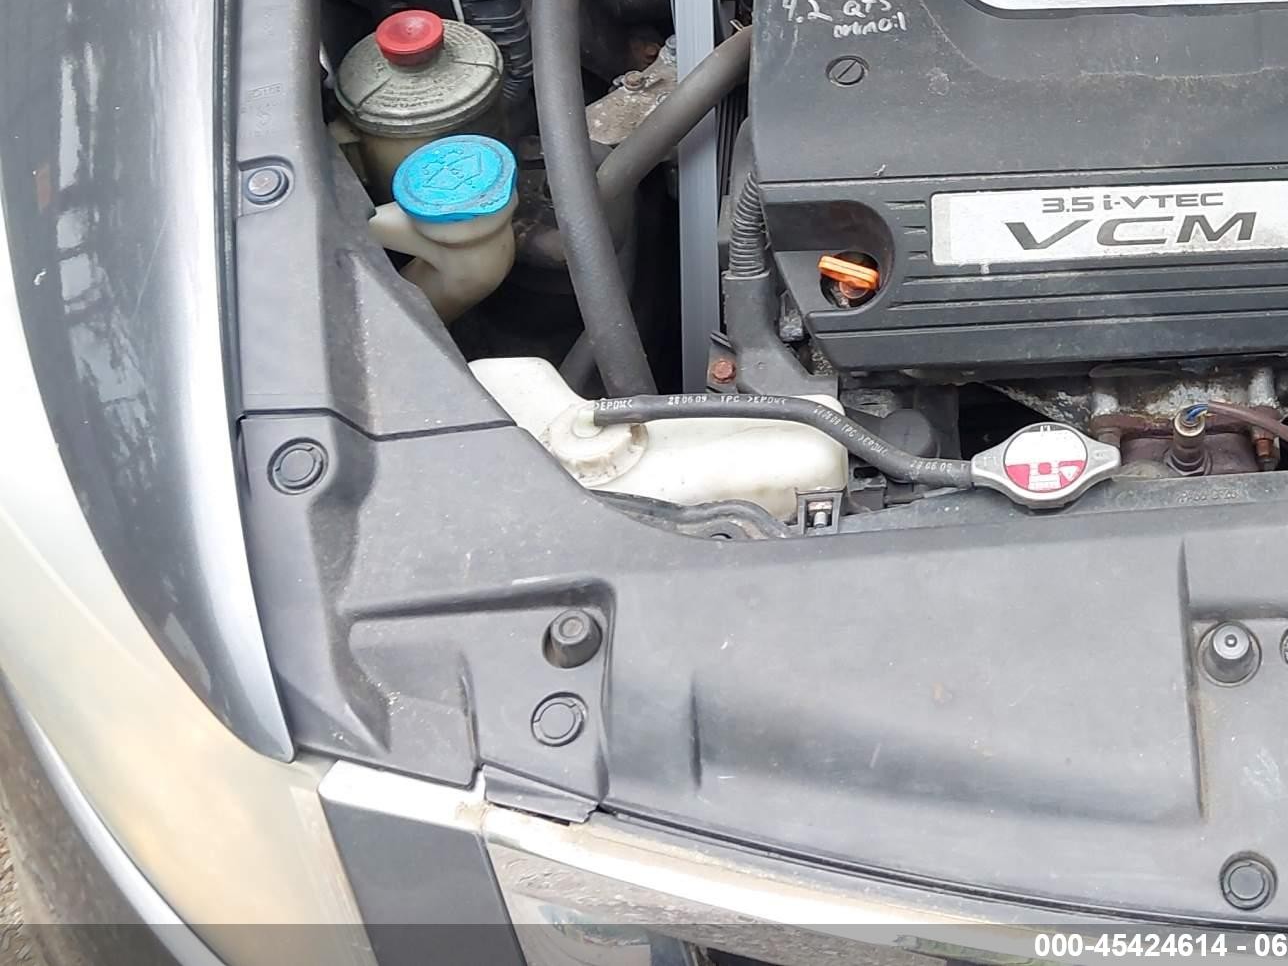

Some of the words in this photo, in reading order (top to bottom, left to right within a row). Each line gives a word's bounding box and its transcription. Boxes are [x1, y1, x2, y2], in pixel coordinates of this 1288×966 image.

[1042, 196, 1095, 214] 3.5
[1103, 192, 1224, 211] i-VTEC
[1005, 212, 1257, 250] VCM
